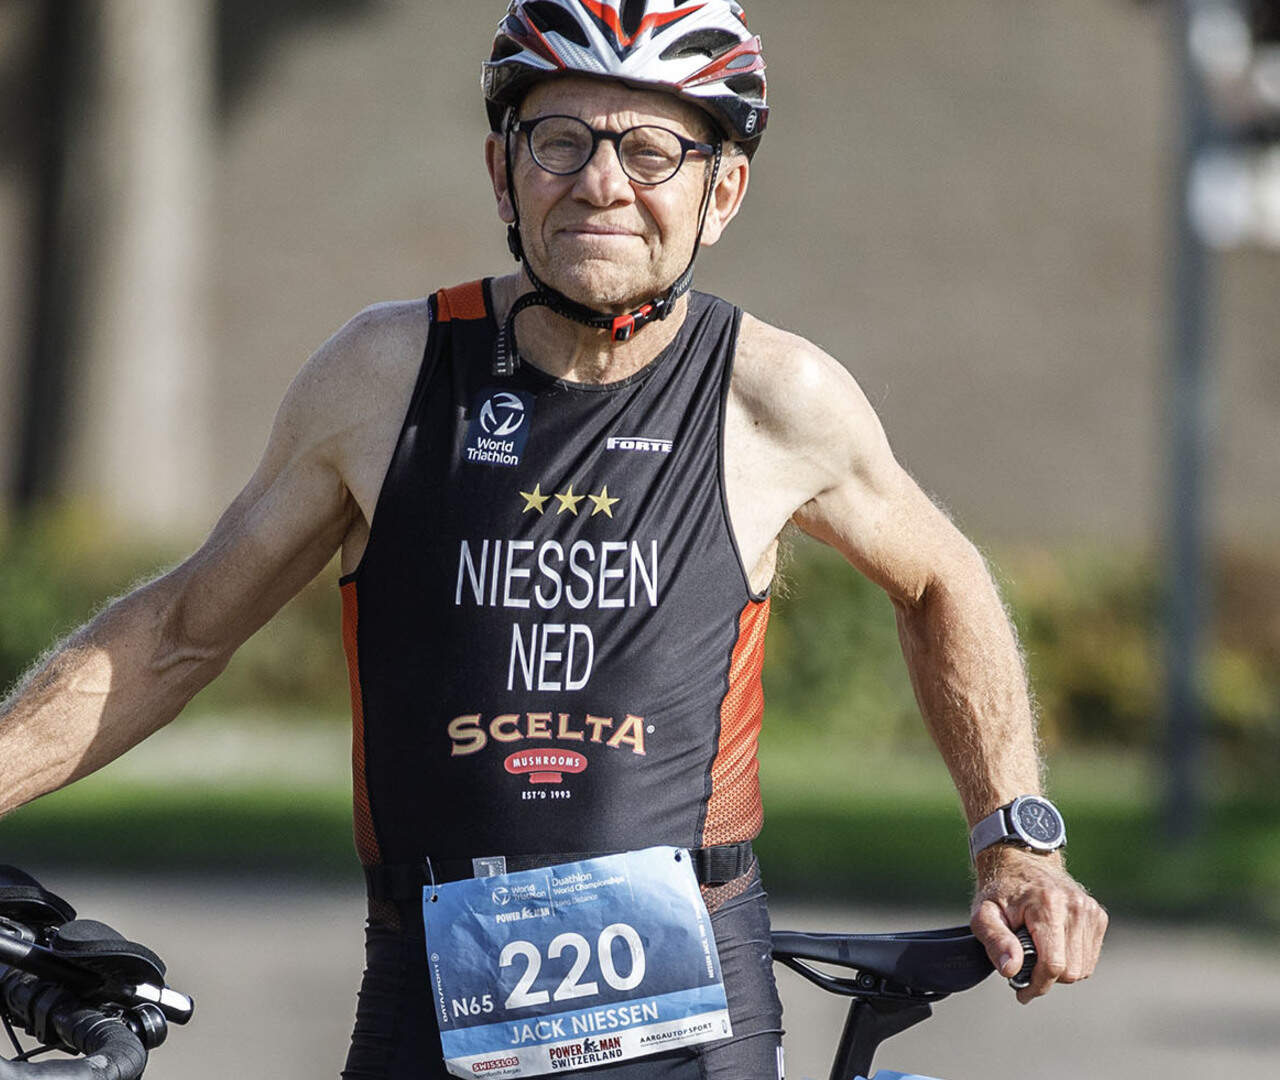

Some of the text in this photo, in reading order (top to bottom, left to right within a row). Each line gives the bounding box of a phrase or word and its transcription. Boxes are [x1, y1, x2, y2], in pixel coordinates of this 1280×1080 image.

[477, 436, 514, 452] World
[606, 436, 673, 453] FORTE
[467, 447, 519, 466] Triathlon
[455, 539, 658, 609] NIESSEN
[507, 623, 594, 692] NED
[447, 712, 646, 756] SCELTA
[512, 756, 580, 769] MUSHROOMS
[550, 789, 571, 799] 1993
[499, 922, 646, 1010] 220
[451, 994, 494, 1018] N65
[511, 1001, 659, 1045] JACK NIESSEN
[549, 1036, 621, 1060] POWER MAN
[472, 1056, 519, 1072] SWISSLOS
[551, 1049, 623, 1070] SWITZERLAND
